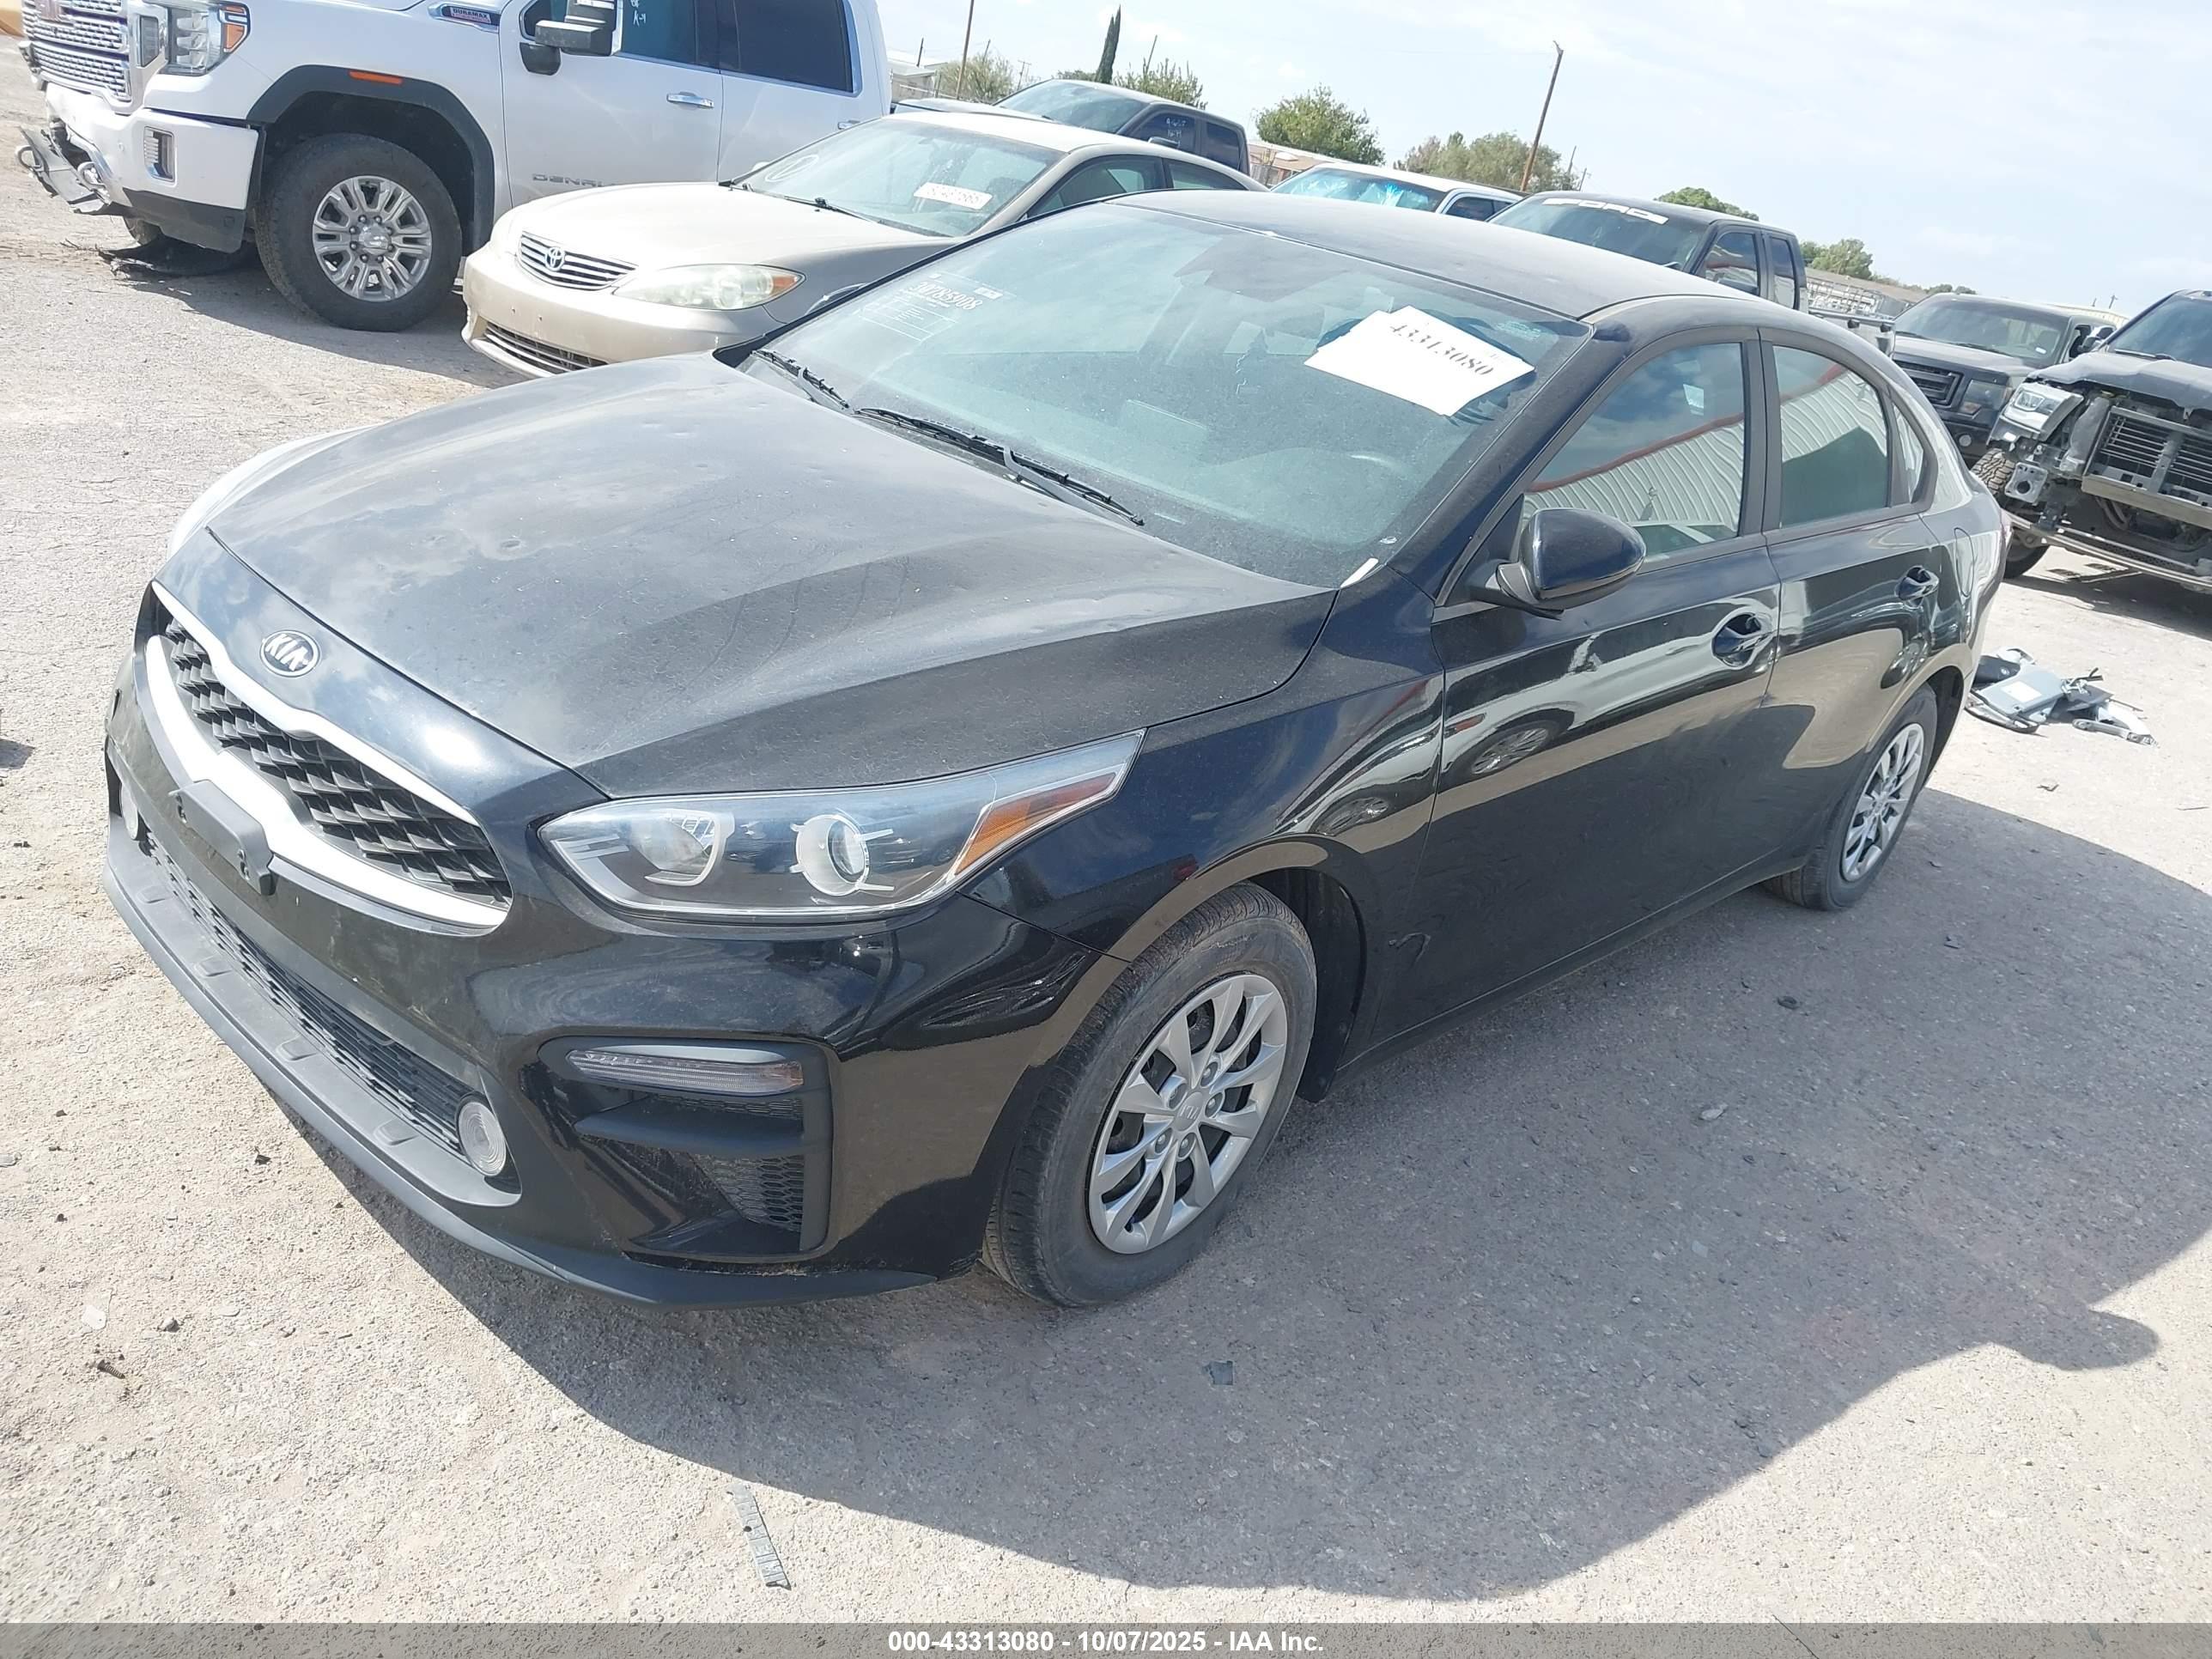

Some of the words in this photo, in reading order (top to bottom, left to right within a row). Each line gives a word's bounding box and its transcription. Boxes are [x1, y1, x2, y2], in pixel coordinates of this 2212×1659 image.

[453, 8, 489, 19] DURAMAX
[1389, 324, 1495, 375] 43313080
[263, 632, 313, 672] KIA
